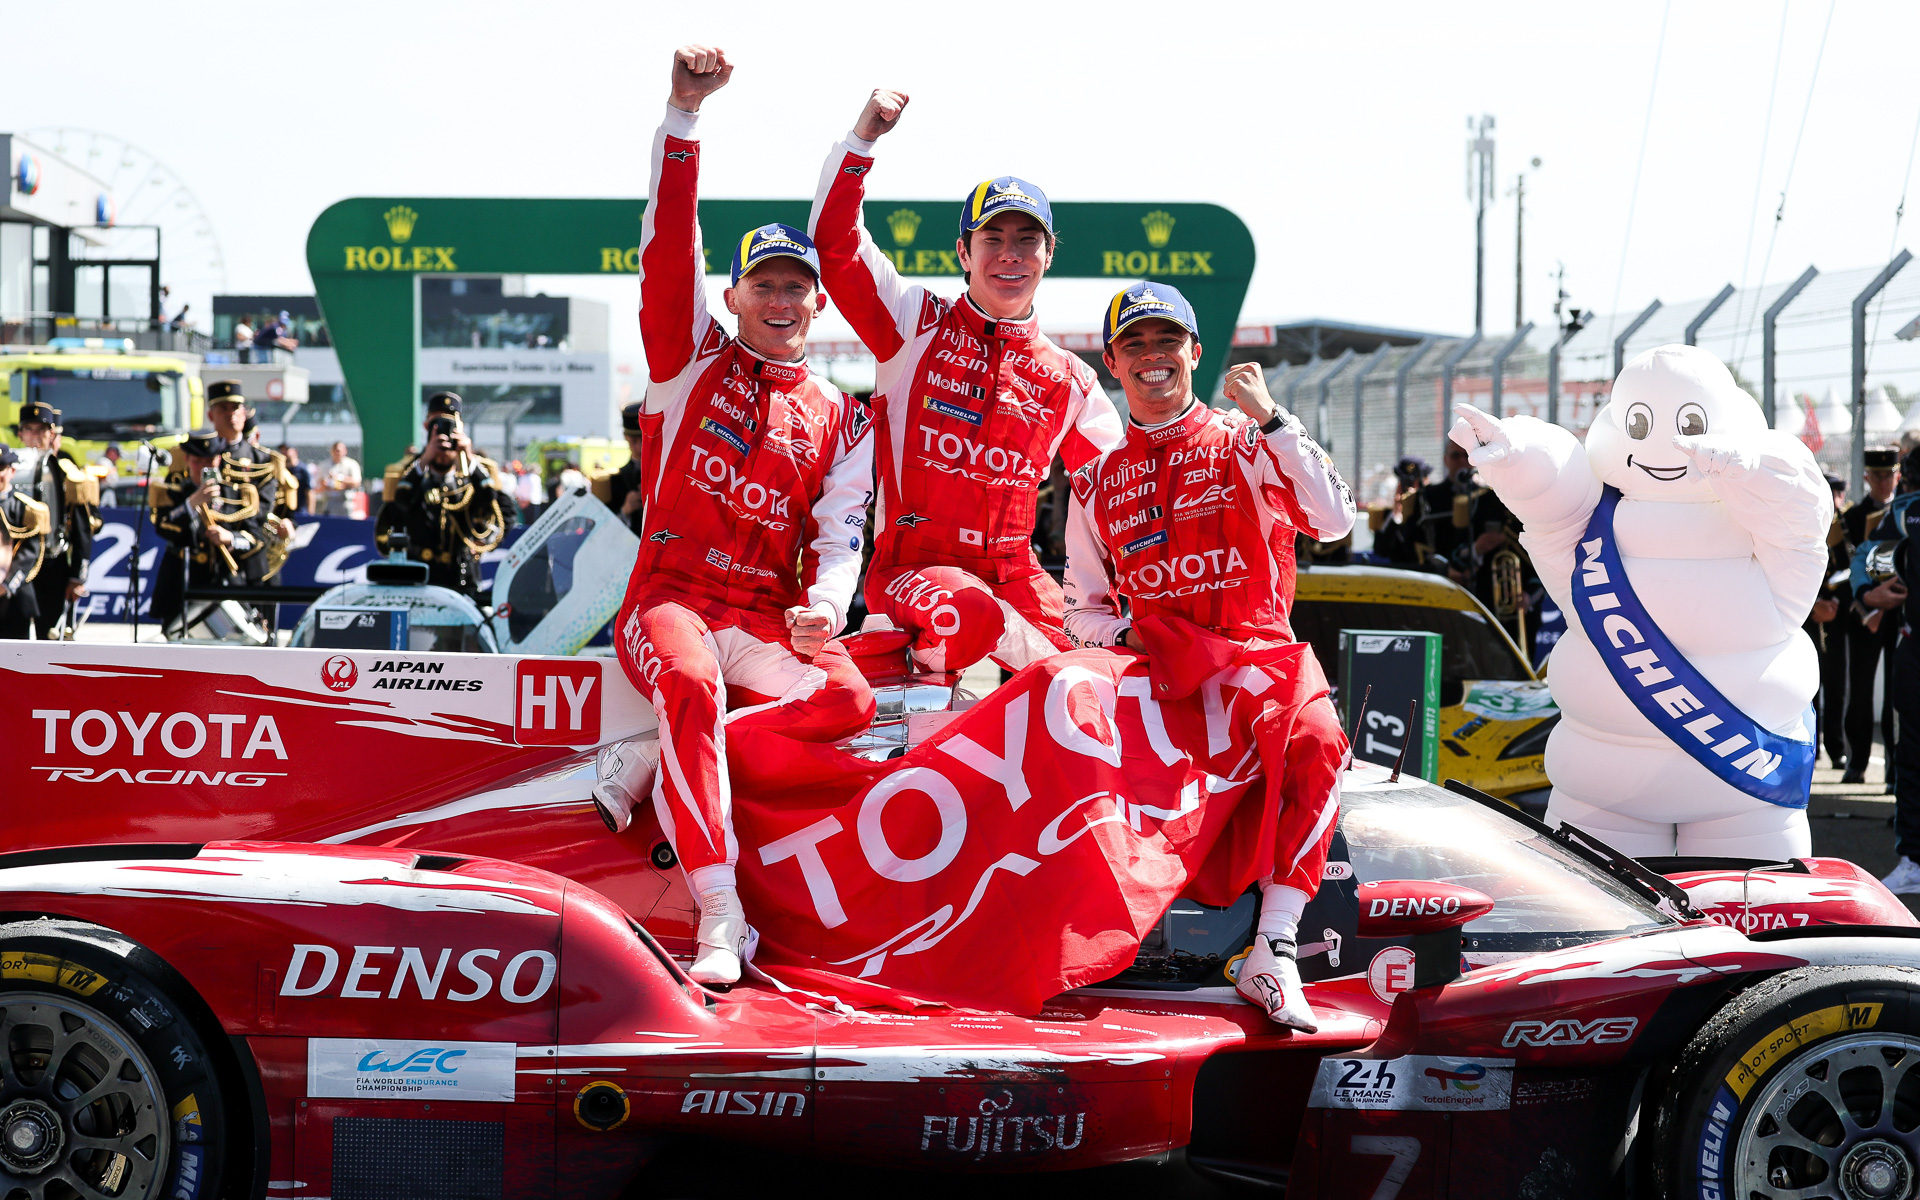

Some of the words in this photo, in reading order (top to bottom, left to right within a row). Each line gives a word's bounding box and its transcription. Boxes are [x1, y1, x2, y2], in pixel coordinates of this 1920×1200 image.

[984, 195, 1039, 208] MICHELIN
[344, 246, 458, 271] ROLEX
[750, 241, 807, 257] MICHELIN
[1102, 251, 1214, 275] ROLEX
[1119, 302, 1175, 321] MICHELIN
[999, 325, 1028, 335] TOYOTA
[765, 365, 796, 378] TOYOTA
[935, 350, 988, 373] AISIN
[1003, 350, 1064, 383] DENSO
[927, 371, 969, 396] Mobil
[939, 405, 977, 421] MICHELIN
[717, 426, 746, 450] MICHELIN
[1150, 425, 1186, 441] TOYOTA
[919, 425, 1036, 478] TOYOTA
[690, 444, 791, 518] TOYOTA
[917, 455, 1031, 488] RACING
[1103, 458, 1157, 491] FUJITSU
[1183, 467, 1221, 485] ZENT
[1108, 481, 1157, 509] AISIN
[1173, 484, 1237, 510] WEC
[1108, 509, 1147, 536] Mobil
[1174, 510, 1217, 522] CHAMPIONSHIP
[1184, 508, 1204, 516] WORLD
[1129, 534, 1162, 551] MICHELIN
[1128, 546, 1248, 591] TOYOTA
[1135, 575, 1250, 599] RACING
[885, 569, 960, 636] DENSO
[368, 661, 444, 673] JAPAN
[1581, 537, 1783, 782] MICHELIN
[372, 678, 484, 691] AIRLINES
[521, 674, 596, 730] HY
[32, 709, 289, 760] TOYOTA
[1365, 710, 1405, 758] T3
[1425, 706, 1437, 738] LMGT3
[31, 766, 288, 787] RACING
[1369, 897, 1461, 917] DENSO
[1710, 913, 1789, 930] OYOTA
[1792, 913, 1809, 927] 7
[0, 960, 30, 970] ORT
[66, 970, 98, 991] M
[279, 944, 557, 1003] DENSO
[1385, 964, 1408, 993] E
[1849, 1006, 1873, 1026] M
[1122, 1027, 1158, 1036] DAIHATSU
[1501, 1016, 1639, 1048] RAYS
[357, 1048, 468, 1074] WEC
[1737, 1051, 1768, 1084] PILOT
[1769, 1024, 1809, 1054] SPORT
[405, 1079, 458, 1087] ENDURANCE
[1336, 1060, 1396, 1089] 24h
[356, 1084, 423, 1092] CHAMPIONSHIP
[1353, 1090, 1392, 1098] MANS
[1423, 1096, 1485, 1104] TotalEnergies
[1774, 1078, 1810, 1121] RAYS
[680, 1089, 806, 1117] AISIN
[921, 1090, 1086, 1161] FUJITSU
[1351, 1135, 1422, 1200] 7
